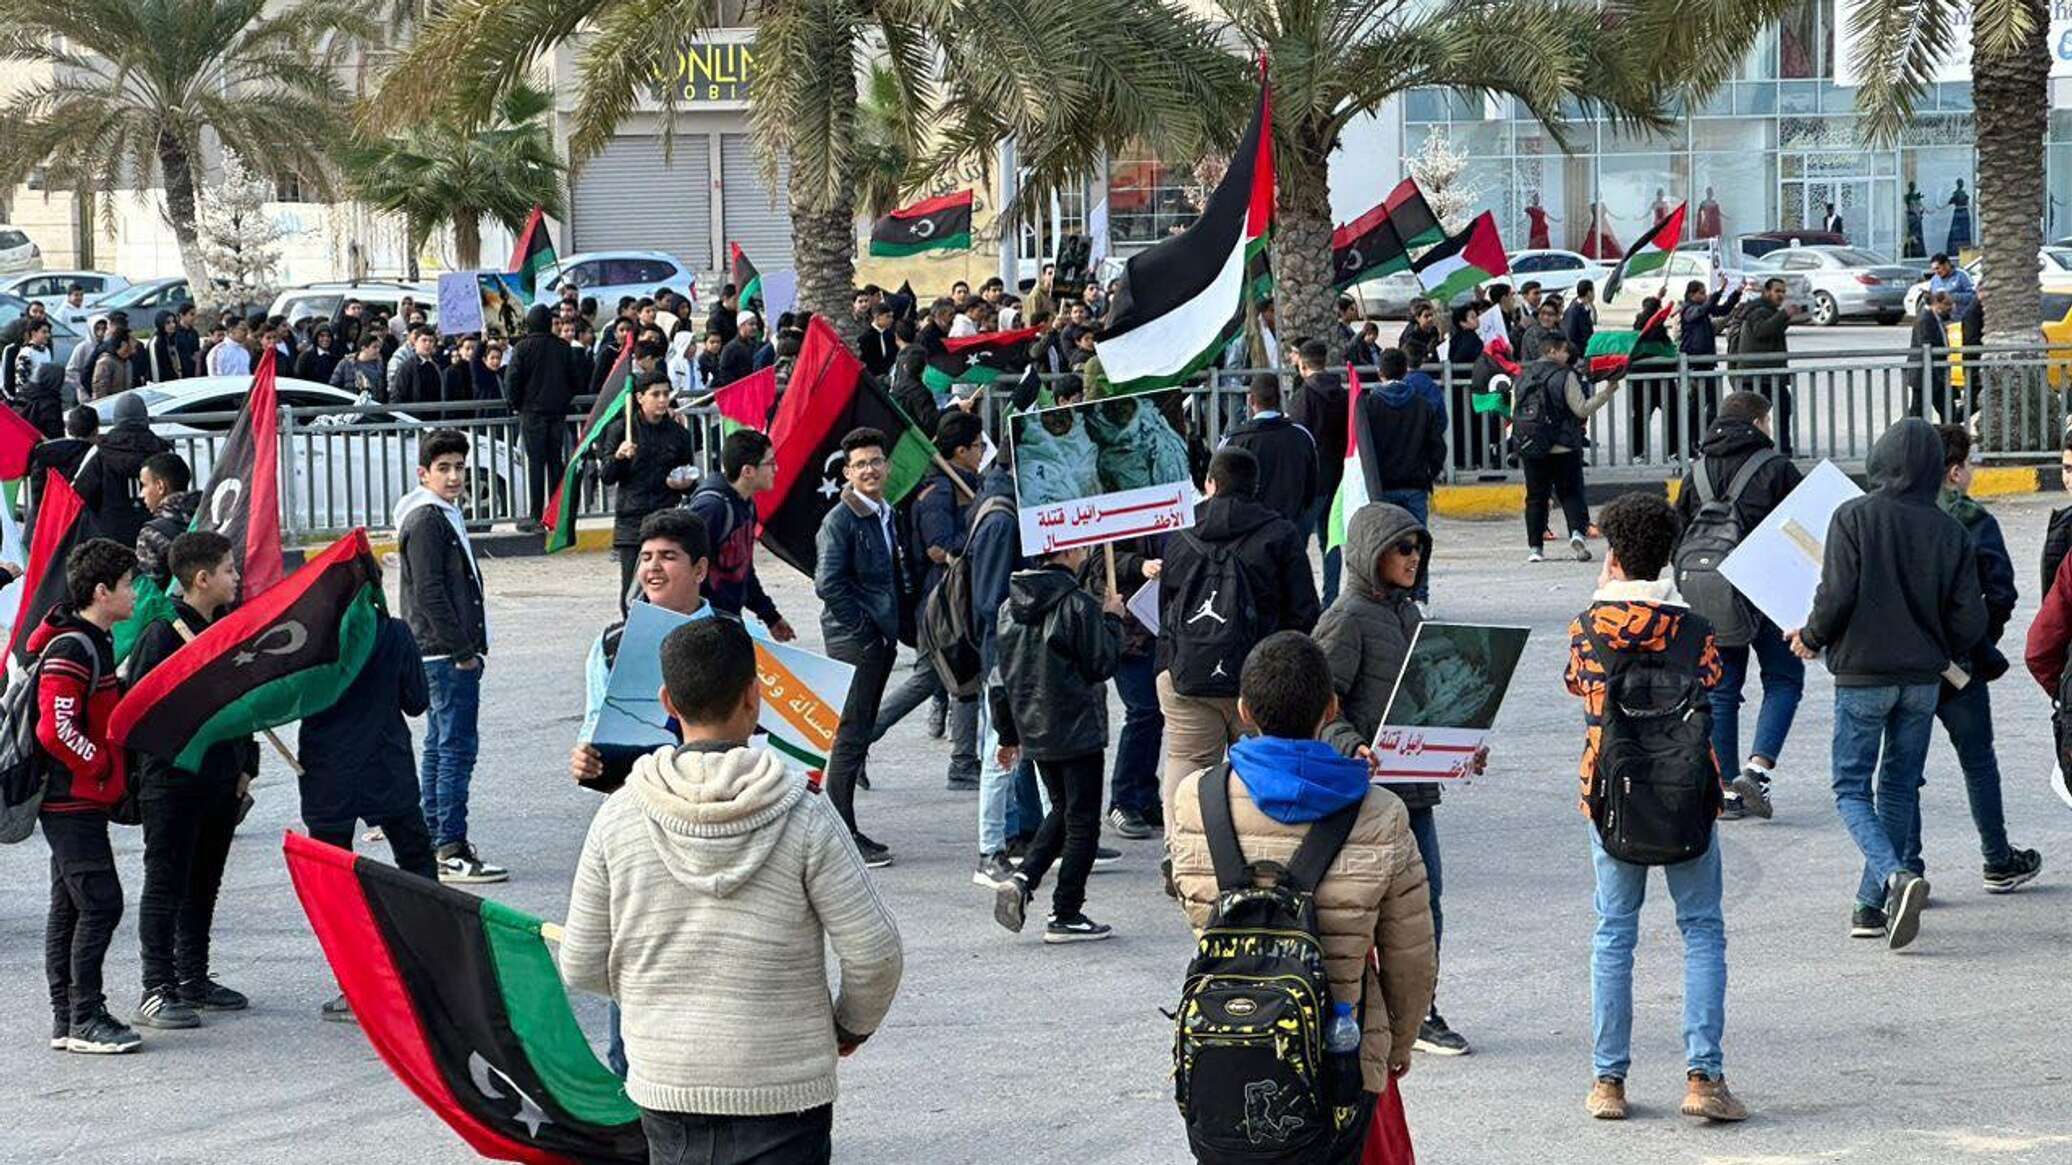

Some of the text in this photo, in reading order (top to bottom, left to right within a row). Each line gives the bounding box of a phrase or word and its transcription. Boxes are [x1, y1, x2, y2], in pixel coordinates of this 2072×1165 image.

[1037, 507, 1065, 527] قتلة
[54, 696, 97, 761] RUNNING
[789, 694, 834, 739] مسألة
